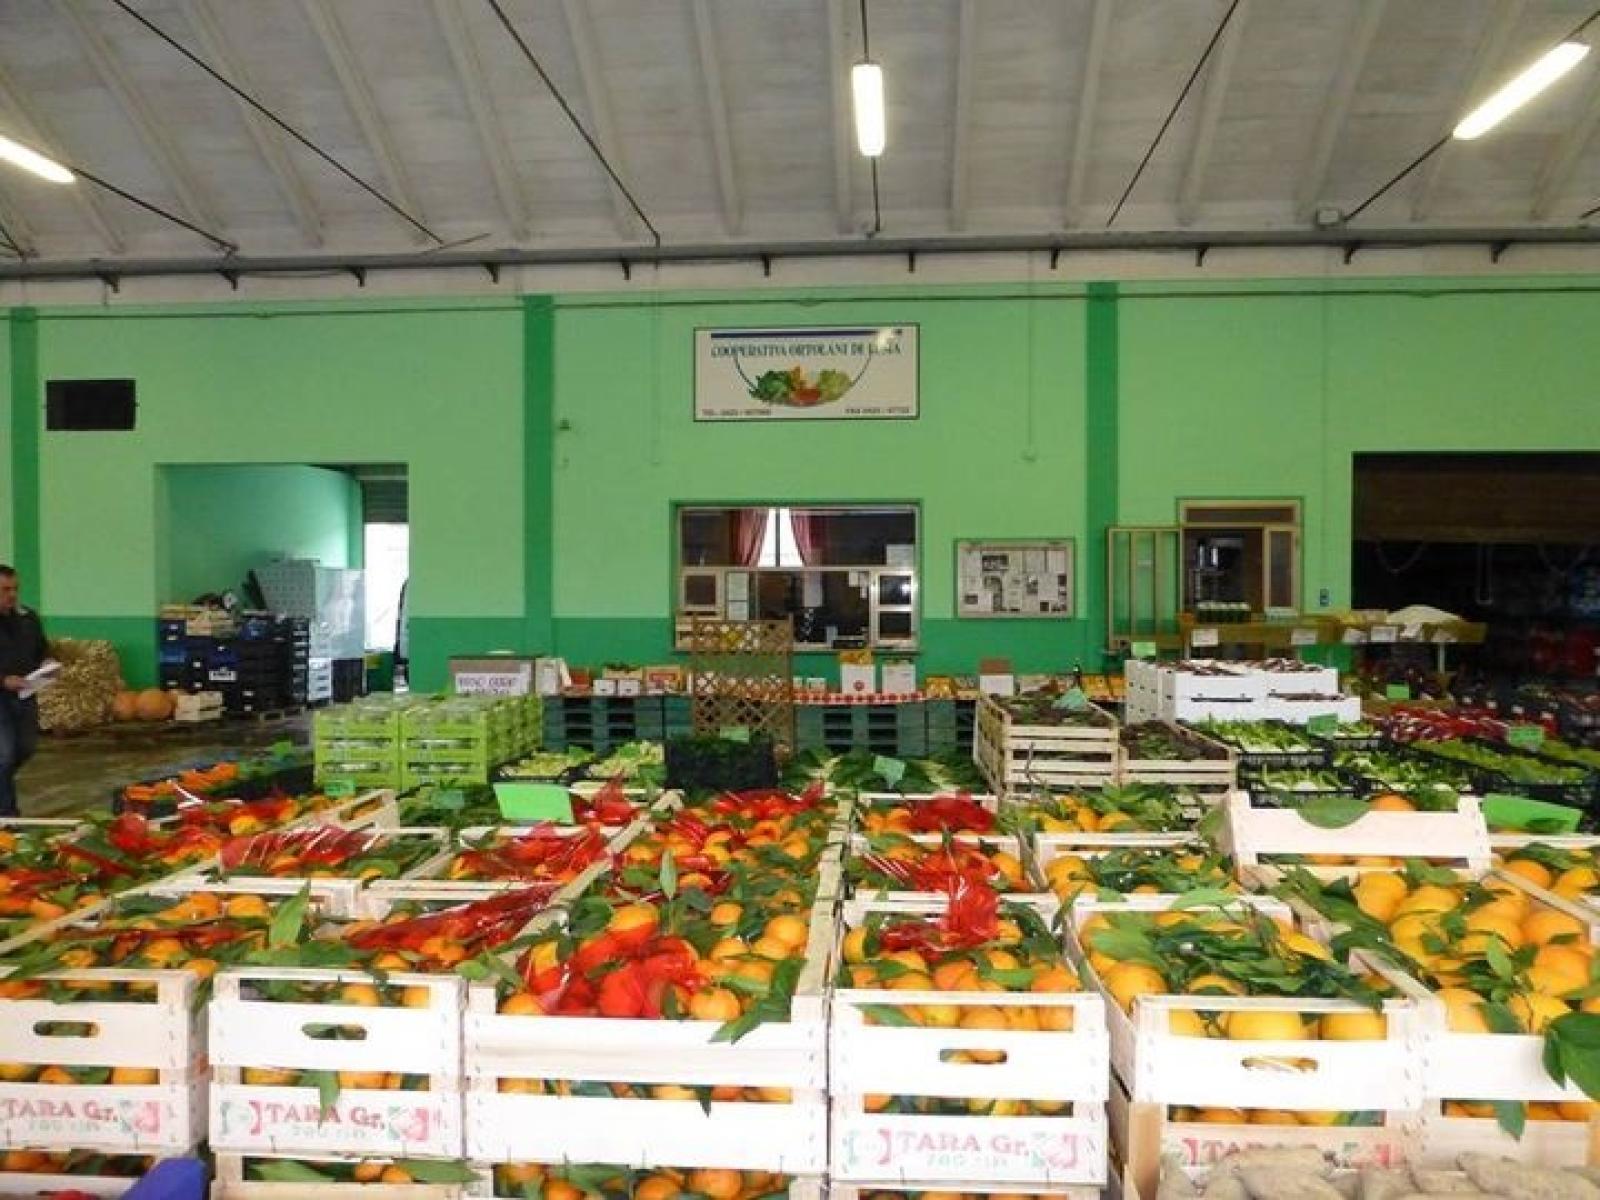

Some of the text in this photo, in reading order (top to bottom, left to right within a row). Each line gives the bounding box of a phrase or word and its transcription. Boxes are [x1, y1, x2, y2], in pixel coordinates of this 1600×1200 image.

[711, 343, 788, 358] COOPERATIVA
[2, 1098, 74, 1119] TARA
[266, 1101, 342, 1124] TARA
[896, 1130, 1030, 1157] TARA Gr.
